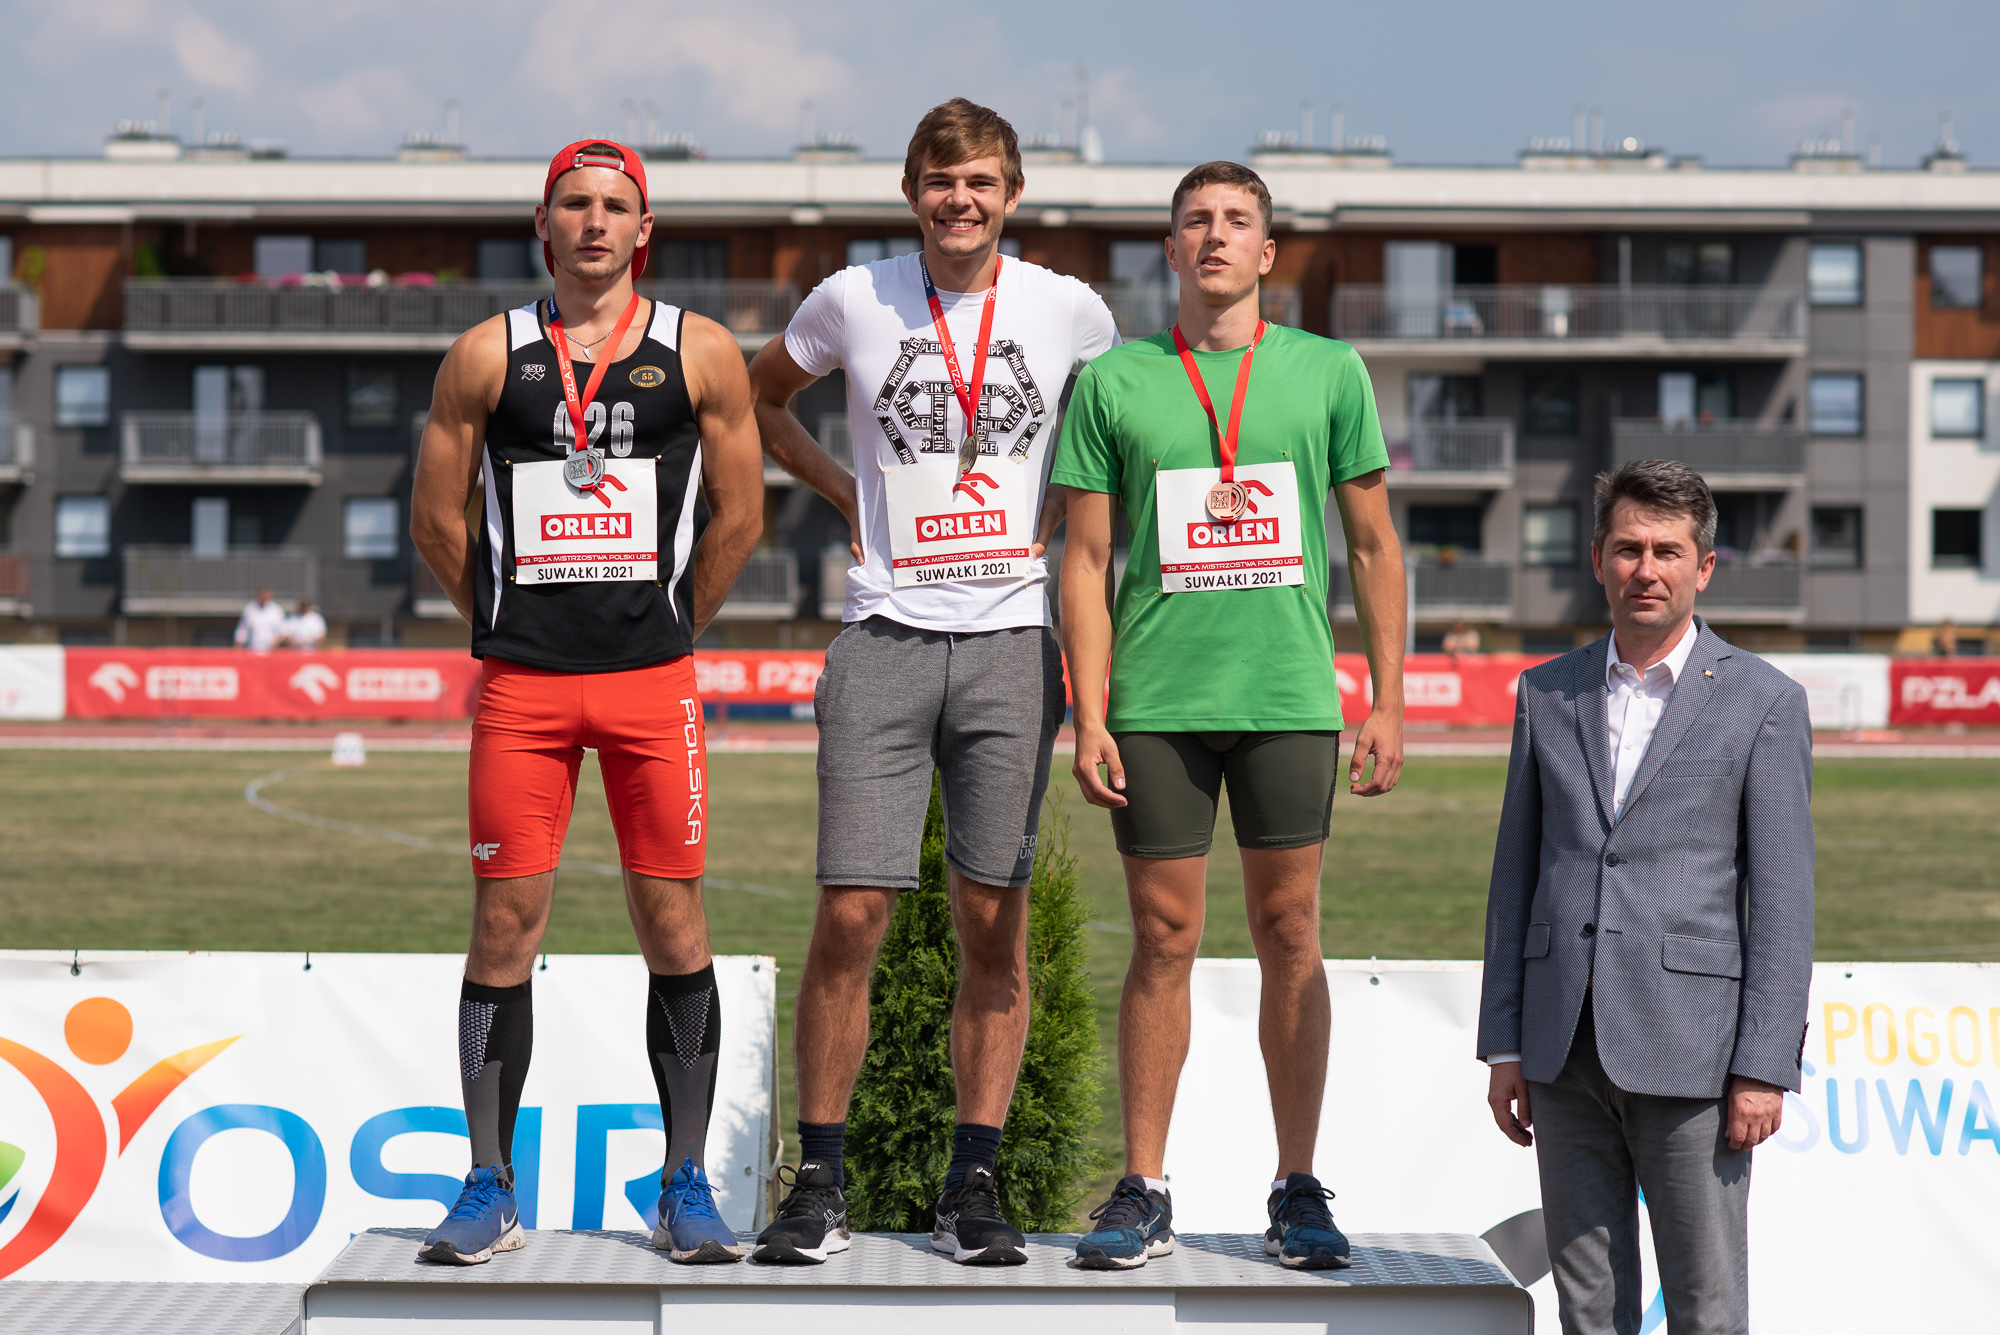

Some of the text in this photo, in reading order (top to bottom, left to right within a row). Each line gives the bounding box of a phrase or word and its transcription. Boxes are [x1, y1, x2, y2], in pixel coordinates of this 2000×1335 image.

[641, 372, 654, 381] 55
[888, 356, 910, 387] PHILIPP
[948, 355, 963, 388] PZLA
[1007, 352, 1030, 384] PHILIPP
[1026, 388, 1043, 413] PLEIN
[563, 371, 577, 402] PZLA
[553, 400, 635, 458] 426
[1003, 407, 1024, 430] 1978
[883, 420, 900, 441] 1978
[934, 424, 945, 451] PLEIN
[545, 516, 626, 537] ORLEN
[920, 513, 1002, 539] ORLEN
[1192, 521, 1274, 545] ORLEN
[553, 554, 608, 562] MISTRZOSTWA
[931, 552, 986, 563] MISTRZOSTWA
[1201, 561, 1257, 570] MISTRZOSTWA
[1258, 558, 1284, 566] POLSKI
[1284, 557, 1299, 565] U23
[537, 566, 633, 581] SUWAŁKI 2021
[916, 562, 1011, 582] SUWAŁKI 2021
[1184, 571, 1282, 589] SUWAŁKI 2021
[680, 697, 703, 846] POLSKA
[471, 842, 501, 861] 4F
[158, 1103, 665, 1263] OSIR
